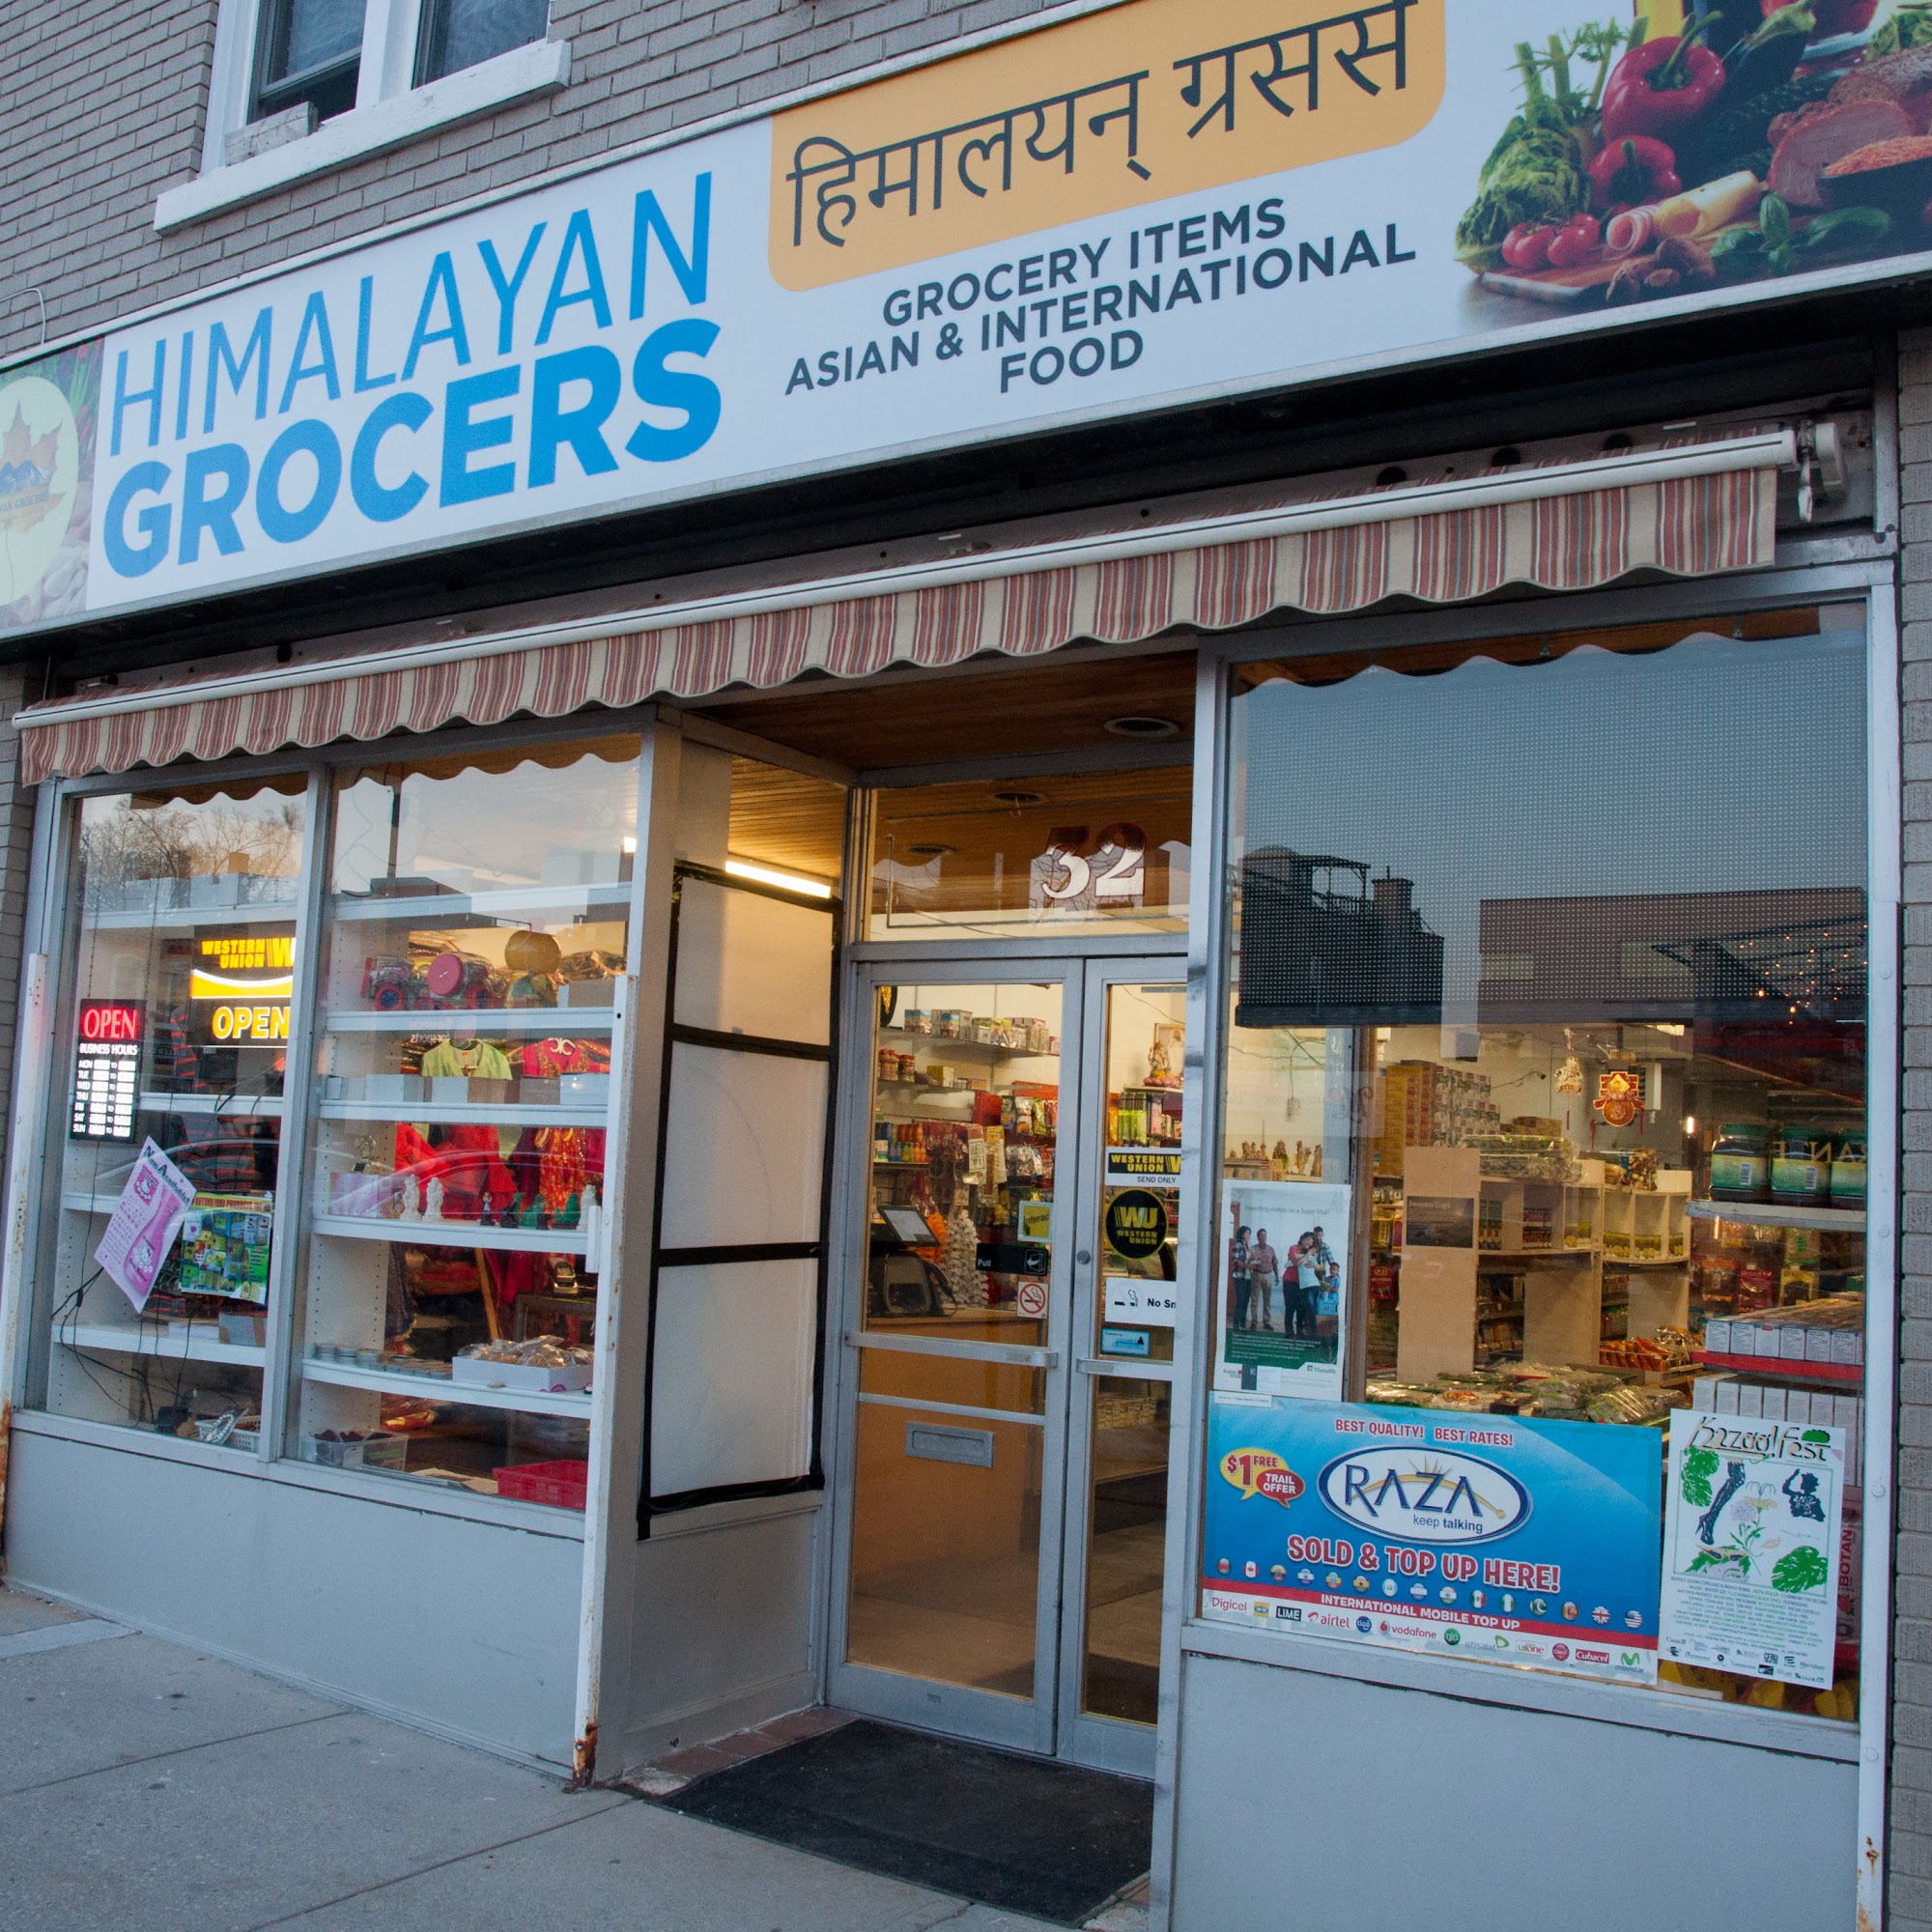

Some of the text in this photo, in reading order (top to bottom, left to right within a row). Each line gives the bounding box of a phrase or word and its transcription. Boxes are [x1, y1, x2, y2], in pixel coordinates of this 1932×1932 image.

[883, 198, 1286, 327] GROCERY ITEMS
[110, 171, 712, 457] HIMALAYAN
[785, 222, 1416, 395] ASIAN & INTERNATIONAL
[1000, 328, 1144, 394] FOOD
[102, 318, 722, 579] GROCERS
[1040, 822, 1148, 899] 52
[201, 938, 266, 955] WESTERN
[219, 953, 265, 969] UNION
[83, 1009, 138, 1039] OPEN
[213, 1007, 291, 1039] OPEN
[79, 1043, 138, 1056] BUSINESS HOURS
[79, 1060, 93, 1068] MON
[78, 1070, 89, 1079] TUE
[77, 1081, 91, 1090] WED
[76, 1092, 89, 1100] THU
[74, 1102, 84, 1111] FRI
[73, 1113, 84, 1122] SAT
[73, 1123, 86, 1132] SUN
[1111, 1154, 1164, 1163] WESTERN
[1127, 1163, 1164, 1173] UNION
[1118, 1207, 1157, 1229] WU
[978, 1259, 991, 1267] Pull
[1148, 1298, 1161, 1308] No
[1335, 1419, 1515, 1446] BEST QUALITY! BEST RATES!
[1227, 1454, 1277, 1487] $1 FREE
[1264, 1473, 1294, 1485] TRAIL
[1263, 1483, 1295, 1494] OFFER
[1344, 1463, 1484, 1518] RAZA
[1413, 1514, 1484, 1534] keep talking
[1288, 1536, 1561, 1593] SOLD & TOP UP HERE!
[1839, 1529, 1853, 1587] BOTAN
[1211, 1597, 1247, 1611] Digicel
[1277, 1607, 1301, 1621] LIME
[1321, 1594, 1520, 1631] INTERNATIONAL MOBILE TOP UP
[1321, 1615, 1350, 1629] airtel
[1391, 1625, 1437, 1639] vodafone
[1465, 1640, 1495, 1652] etisalat
[1576, 1651, 1608, 1663] Cubacel
[1615, 1664, 1644, 1673] movistar
